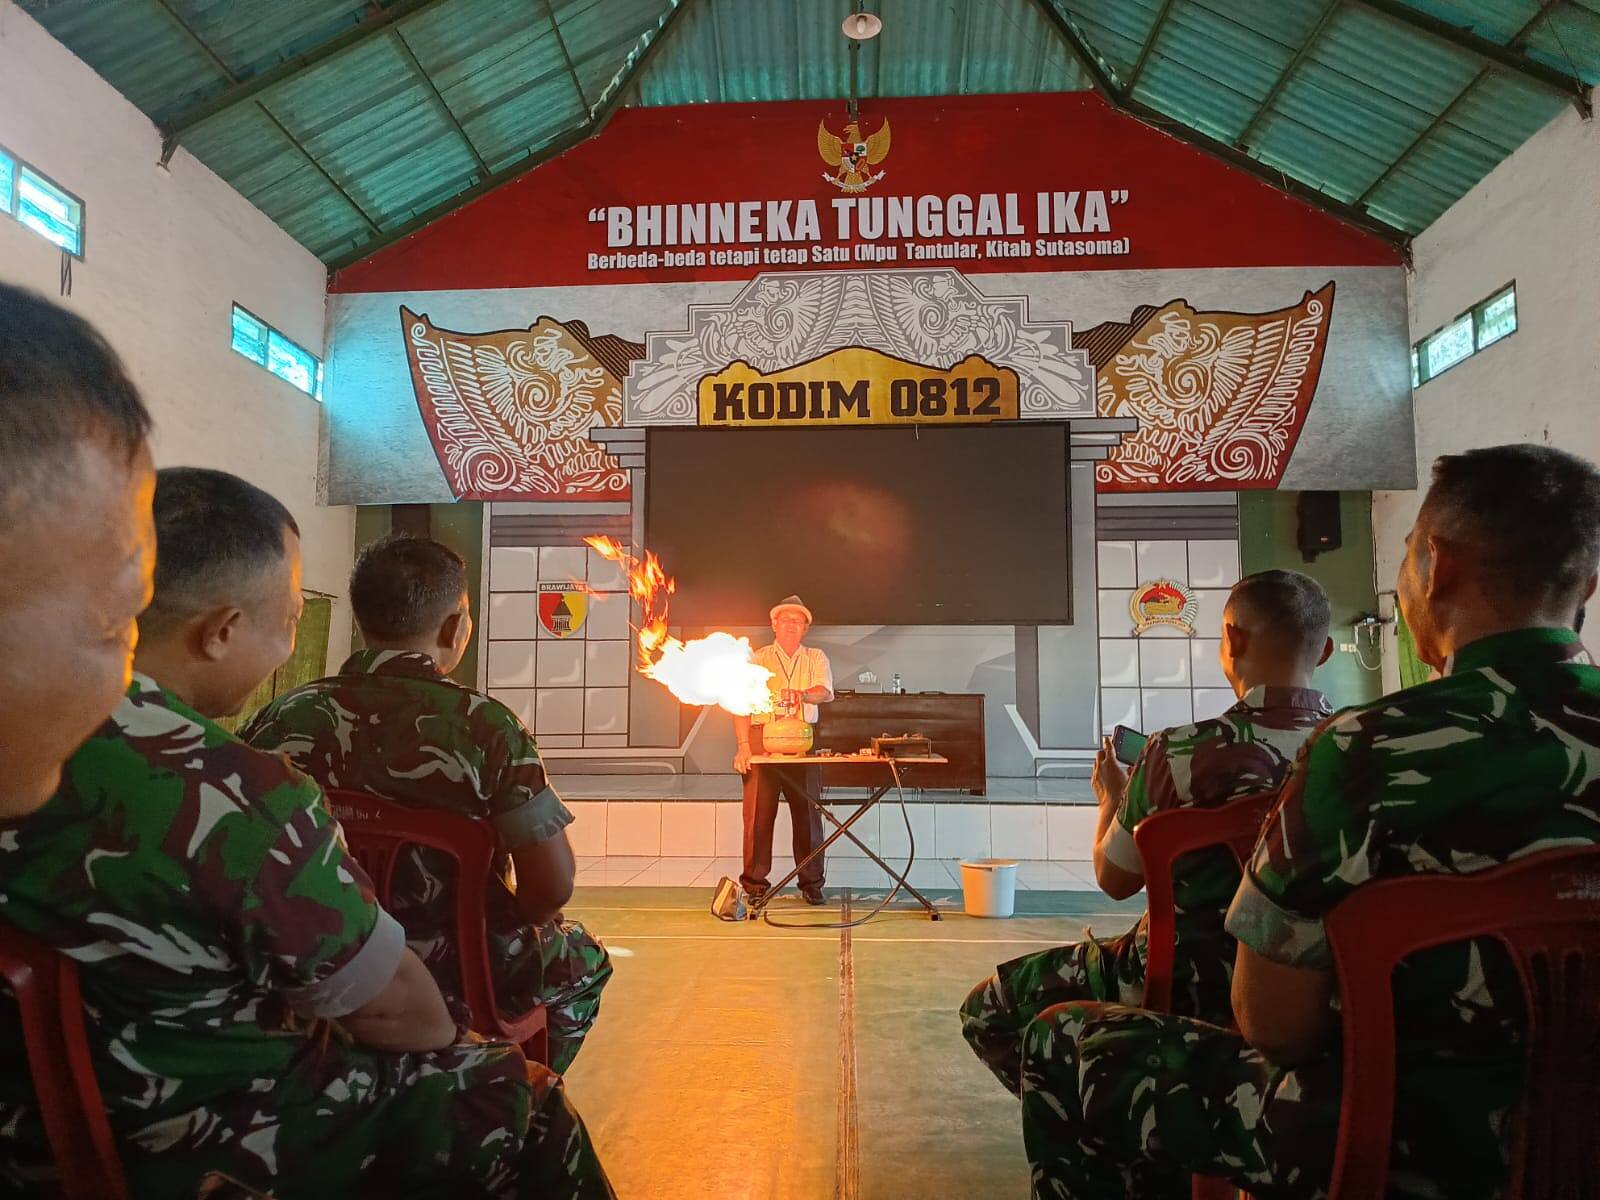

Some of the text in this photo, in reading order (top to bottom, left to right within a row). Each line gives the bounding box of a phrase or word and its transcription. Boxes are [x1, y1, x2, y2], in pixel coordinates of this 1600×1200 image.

[588, 190, 1129, 247] “BHINNEKA TUNGGAL IKA”
[588, 237, 1130, 270] Berbeda-beda tetapi tetap Satu (Mpu Tantular, Kitab Sutasoma)
[712, 377, 1001, 421] KODIM 0812
